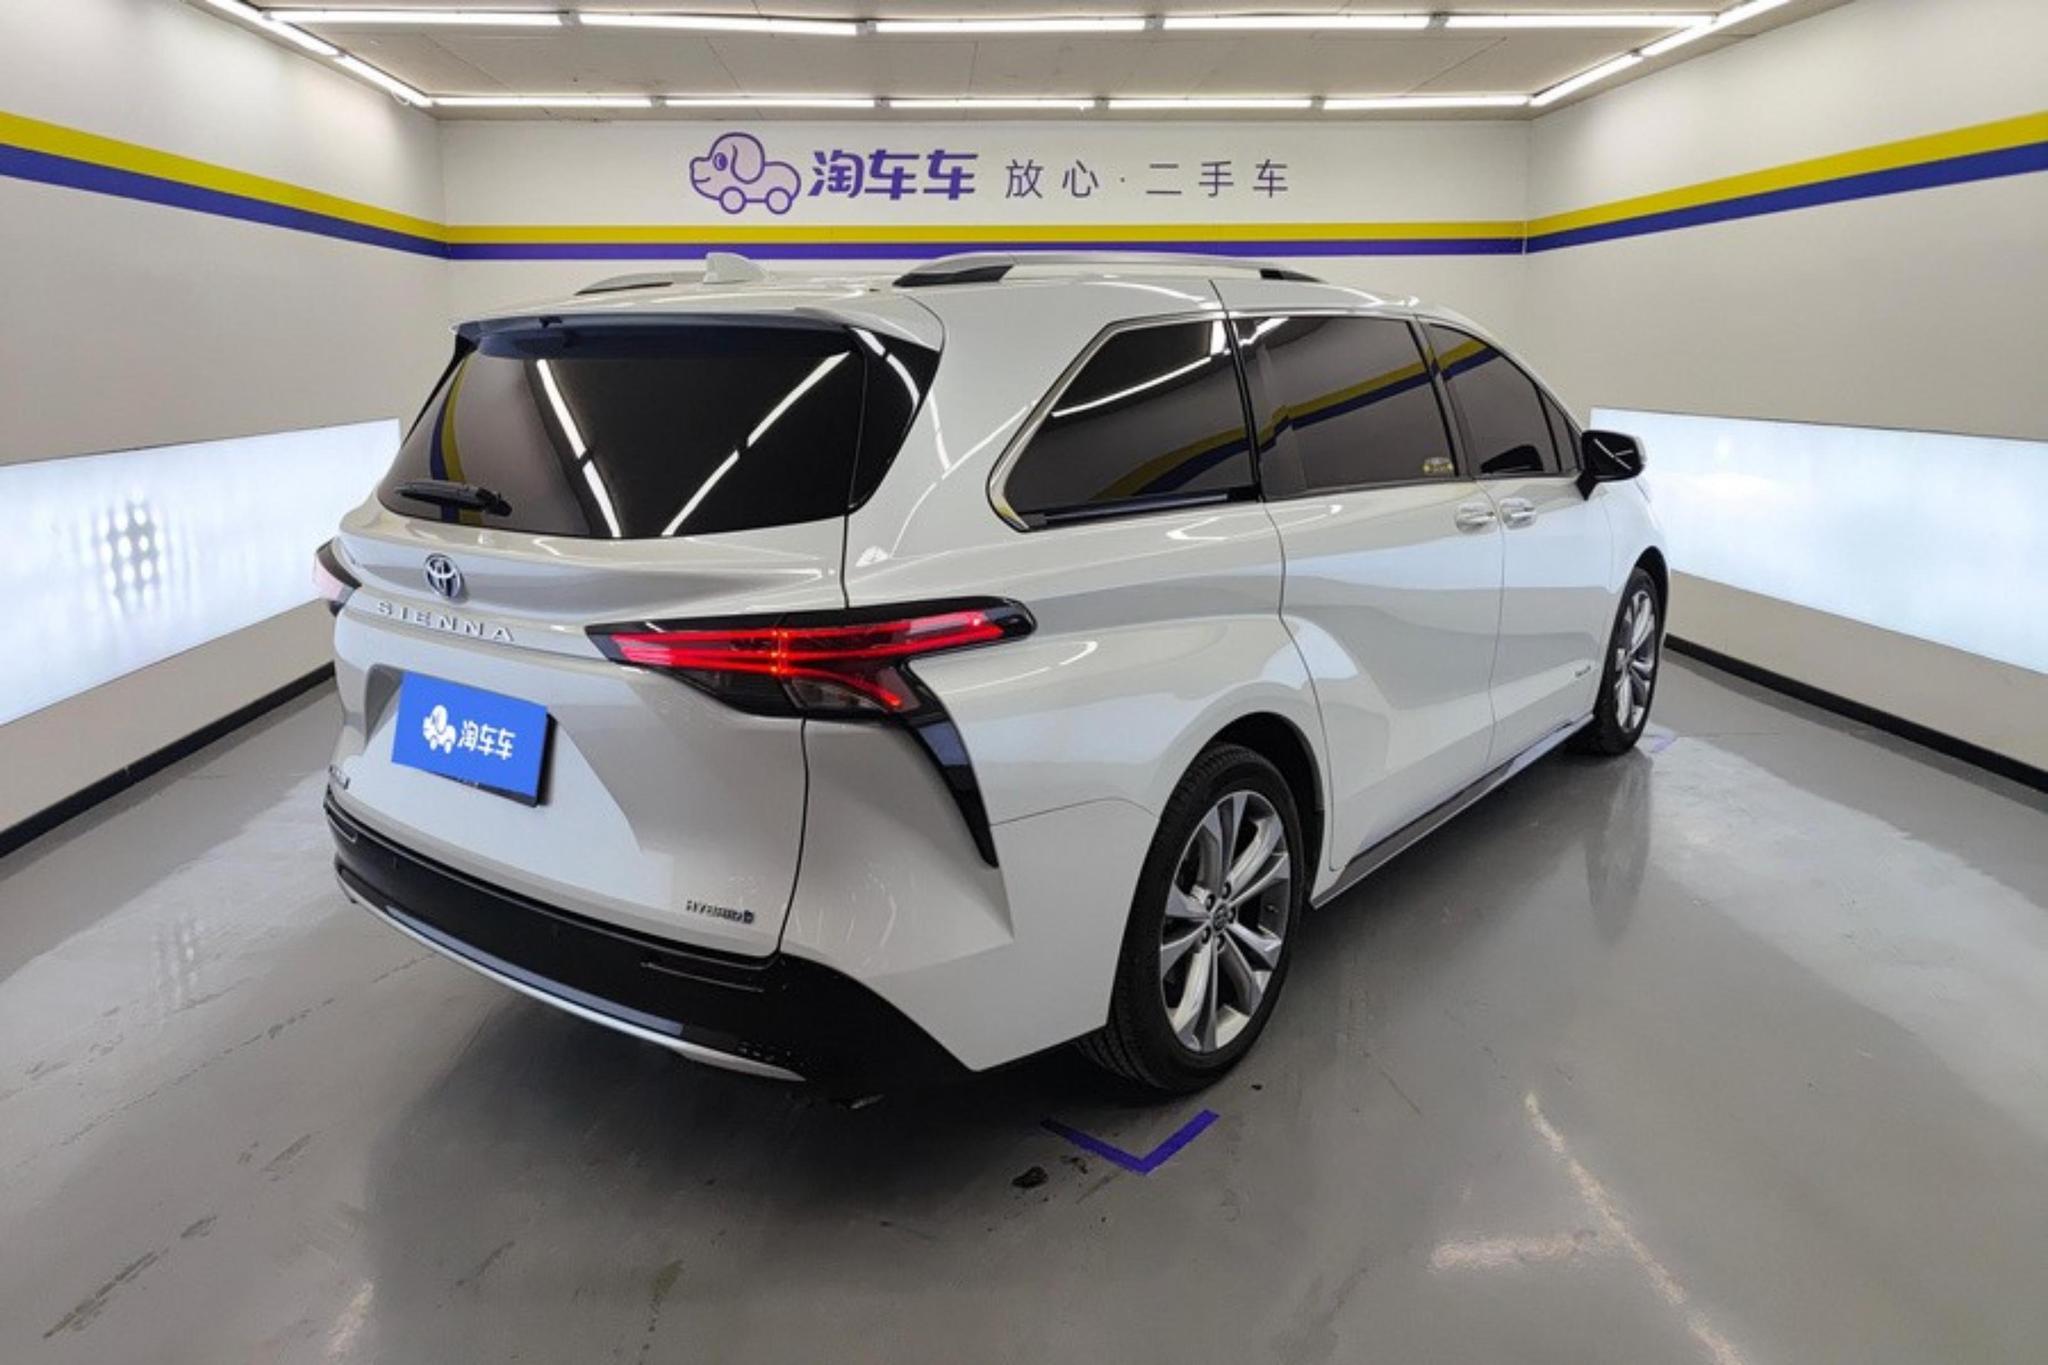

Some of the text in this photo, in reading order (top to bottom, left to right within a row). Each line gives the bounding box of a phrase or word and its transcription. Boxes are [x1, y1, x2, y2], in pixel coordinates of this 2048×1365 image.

[808, 149, 978, 200] 淘车车
[378, 600, 515, 642] SIENNA
